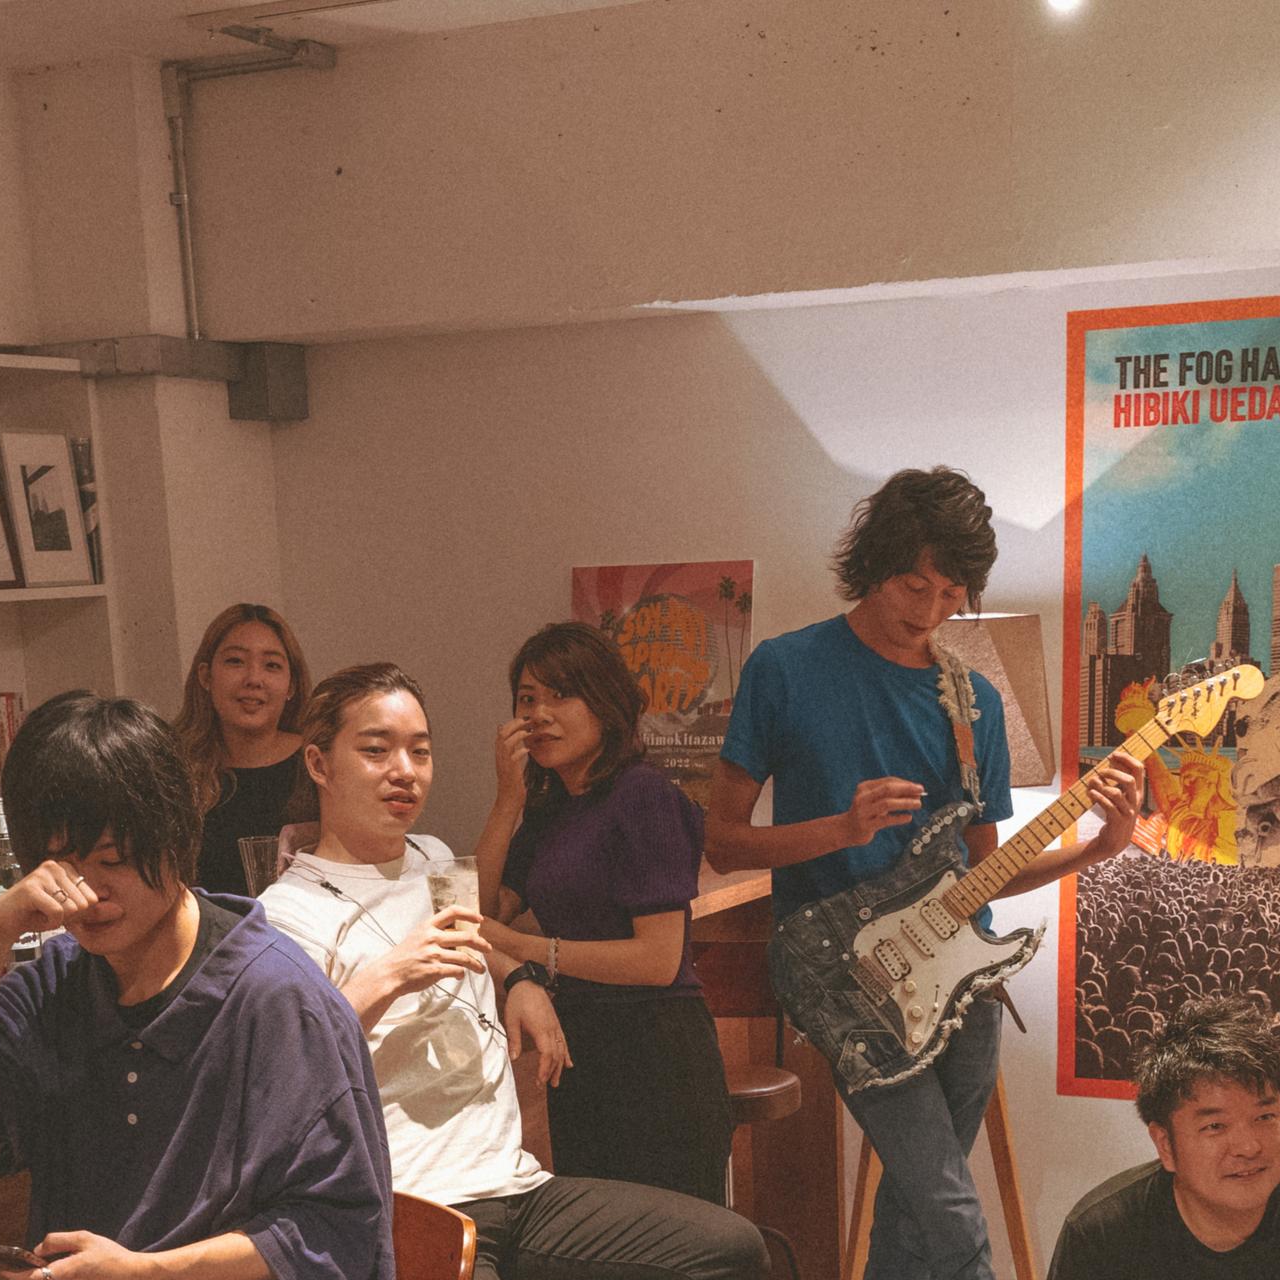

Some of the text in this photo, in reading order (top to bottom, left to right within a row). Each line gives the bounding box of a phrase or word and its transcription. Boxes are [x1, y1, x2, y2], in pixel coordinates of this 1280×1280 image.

[1114, 353, 1170, 391] THE
[1178, 349, 1233, 387] FOG
[1113, 388, 1200, 428] HIBIKI
[639, 731, 725, 746] himokitazaw
